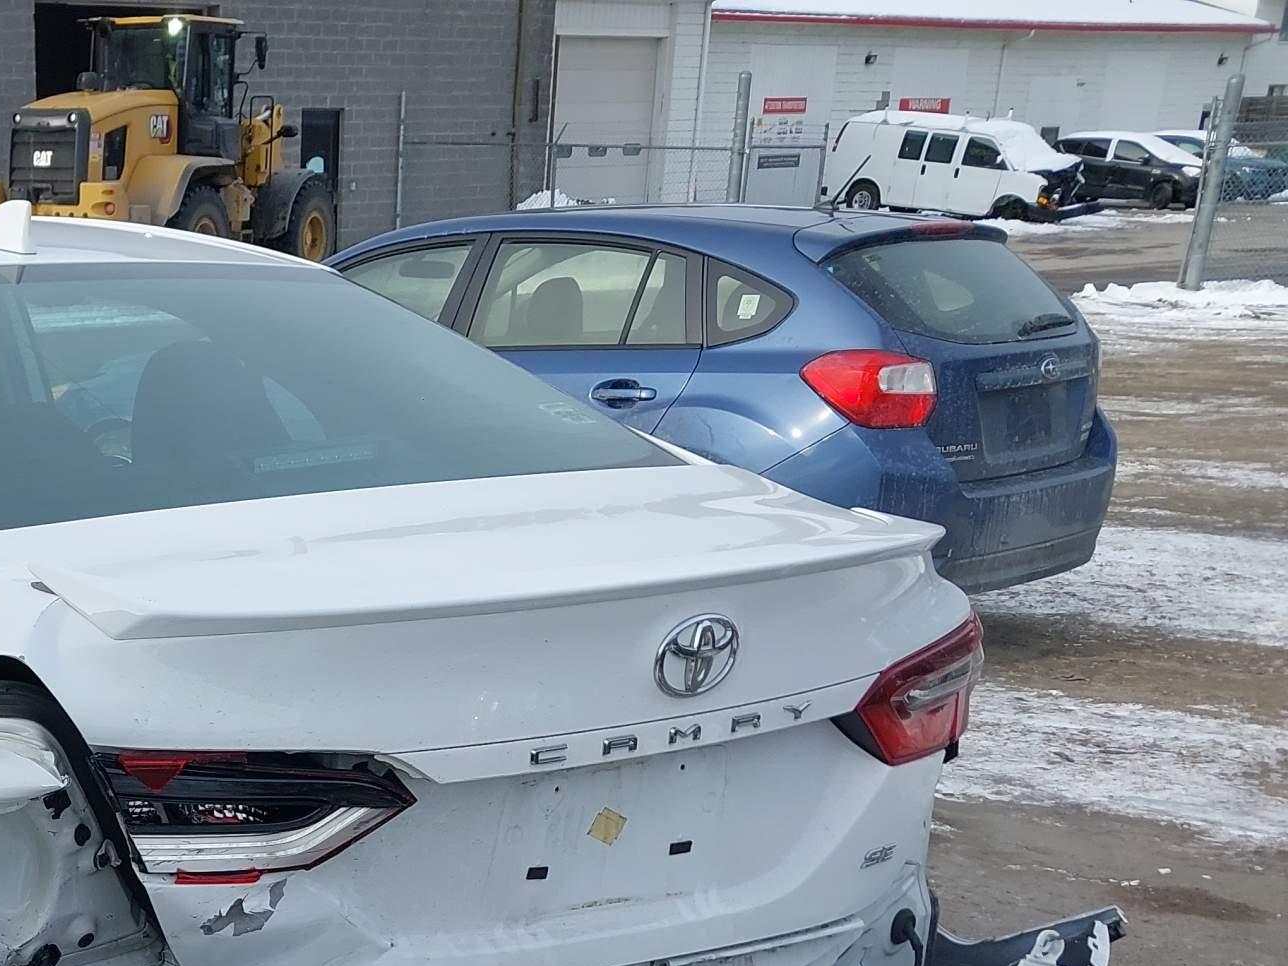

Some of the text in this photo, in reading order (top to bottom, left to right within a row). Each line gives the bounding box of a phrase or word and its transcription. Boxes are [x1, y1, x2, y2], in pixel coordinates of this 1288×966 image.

[150, 115, 169, 138] CAT
[33, 150, 53, 167] CAT
[530, 701, 812, 766] CAMRY
[860, 841, 897, 870] SE
